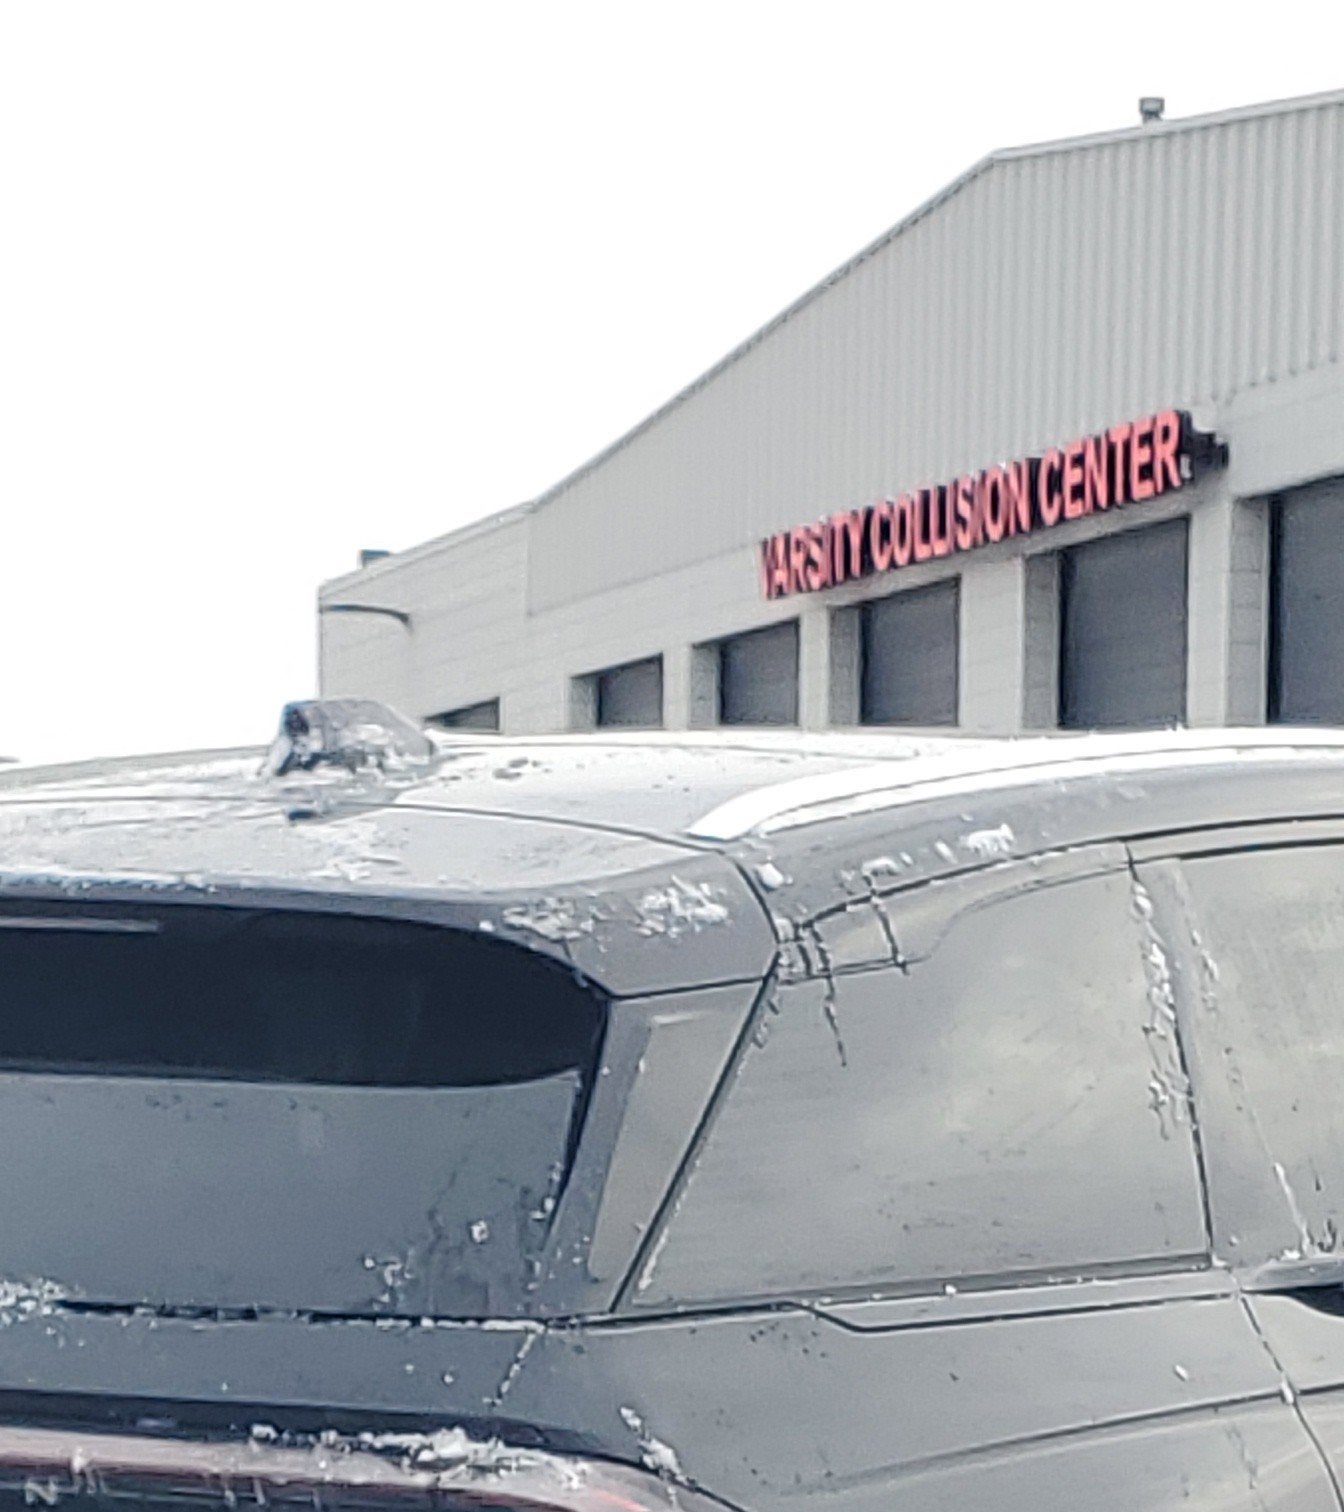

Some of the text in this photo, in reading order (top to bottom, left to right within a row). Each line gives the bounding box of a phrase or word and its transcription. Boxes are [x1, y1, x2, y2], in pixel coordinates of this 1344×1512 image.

[758, 409, 1182, 600] VARSITY COLLISION CENTER
